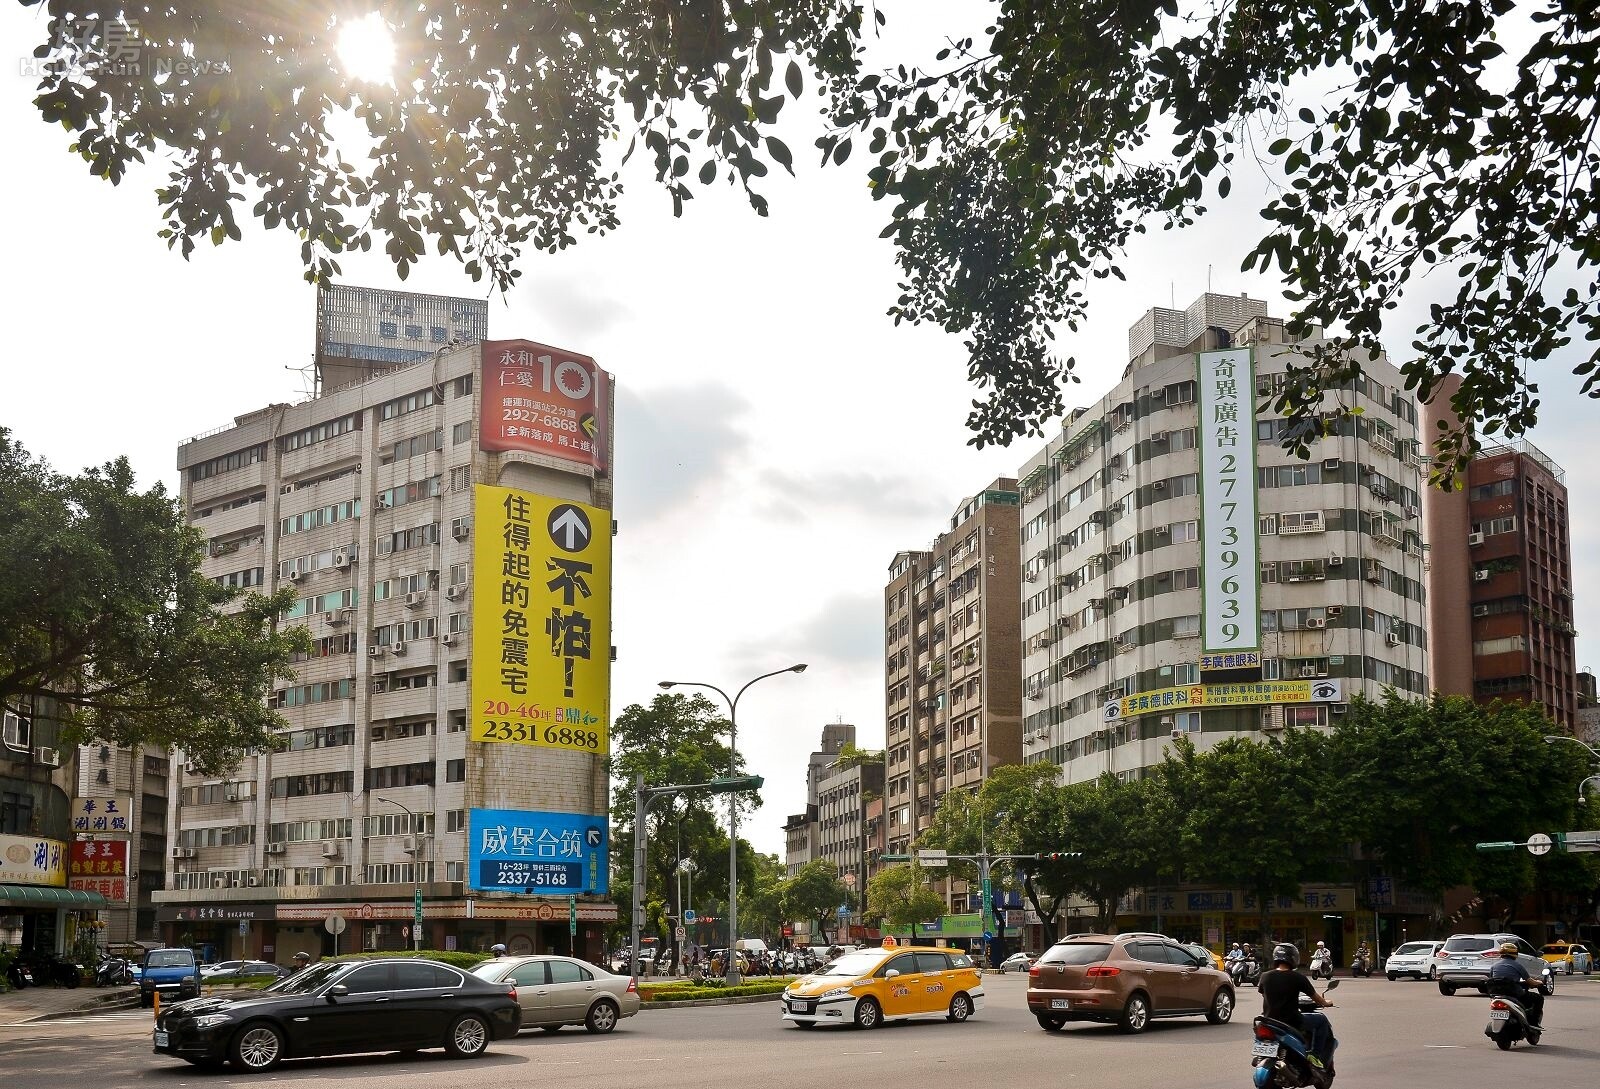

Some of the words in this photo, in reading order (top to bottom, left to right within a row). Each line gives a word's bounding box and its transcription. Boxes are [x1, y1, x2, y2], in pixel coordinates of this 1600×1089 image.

[500, 349, 534, 367] 永和
[498, 370, 534, 388] 仁愛
[537, 354, 599, 409] 101
[502, 408, 578, 433] 2927-6868
[500, 493, 531, 696] 住得起的免震宅
[1200, 653, 1259, 670] 李廣德眼科
[1128, 690, 1188, 713] 李廣德眼科
[1190, 687, 1203, 705] 內科
[482, 720, 539, 742] 2331
[543, 724, 599, 749] 6888
[82, 799, 119, 815] 華王
[75, 816, 127, 831] 涮涮鍋
[83, 841, 114, 859] 華王
[480, 825, 583, 858] 威堡合筑
[497, 871, 568, 886] 2337-5168
[1303, 891, 1337, 908] 雨衣
